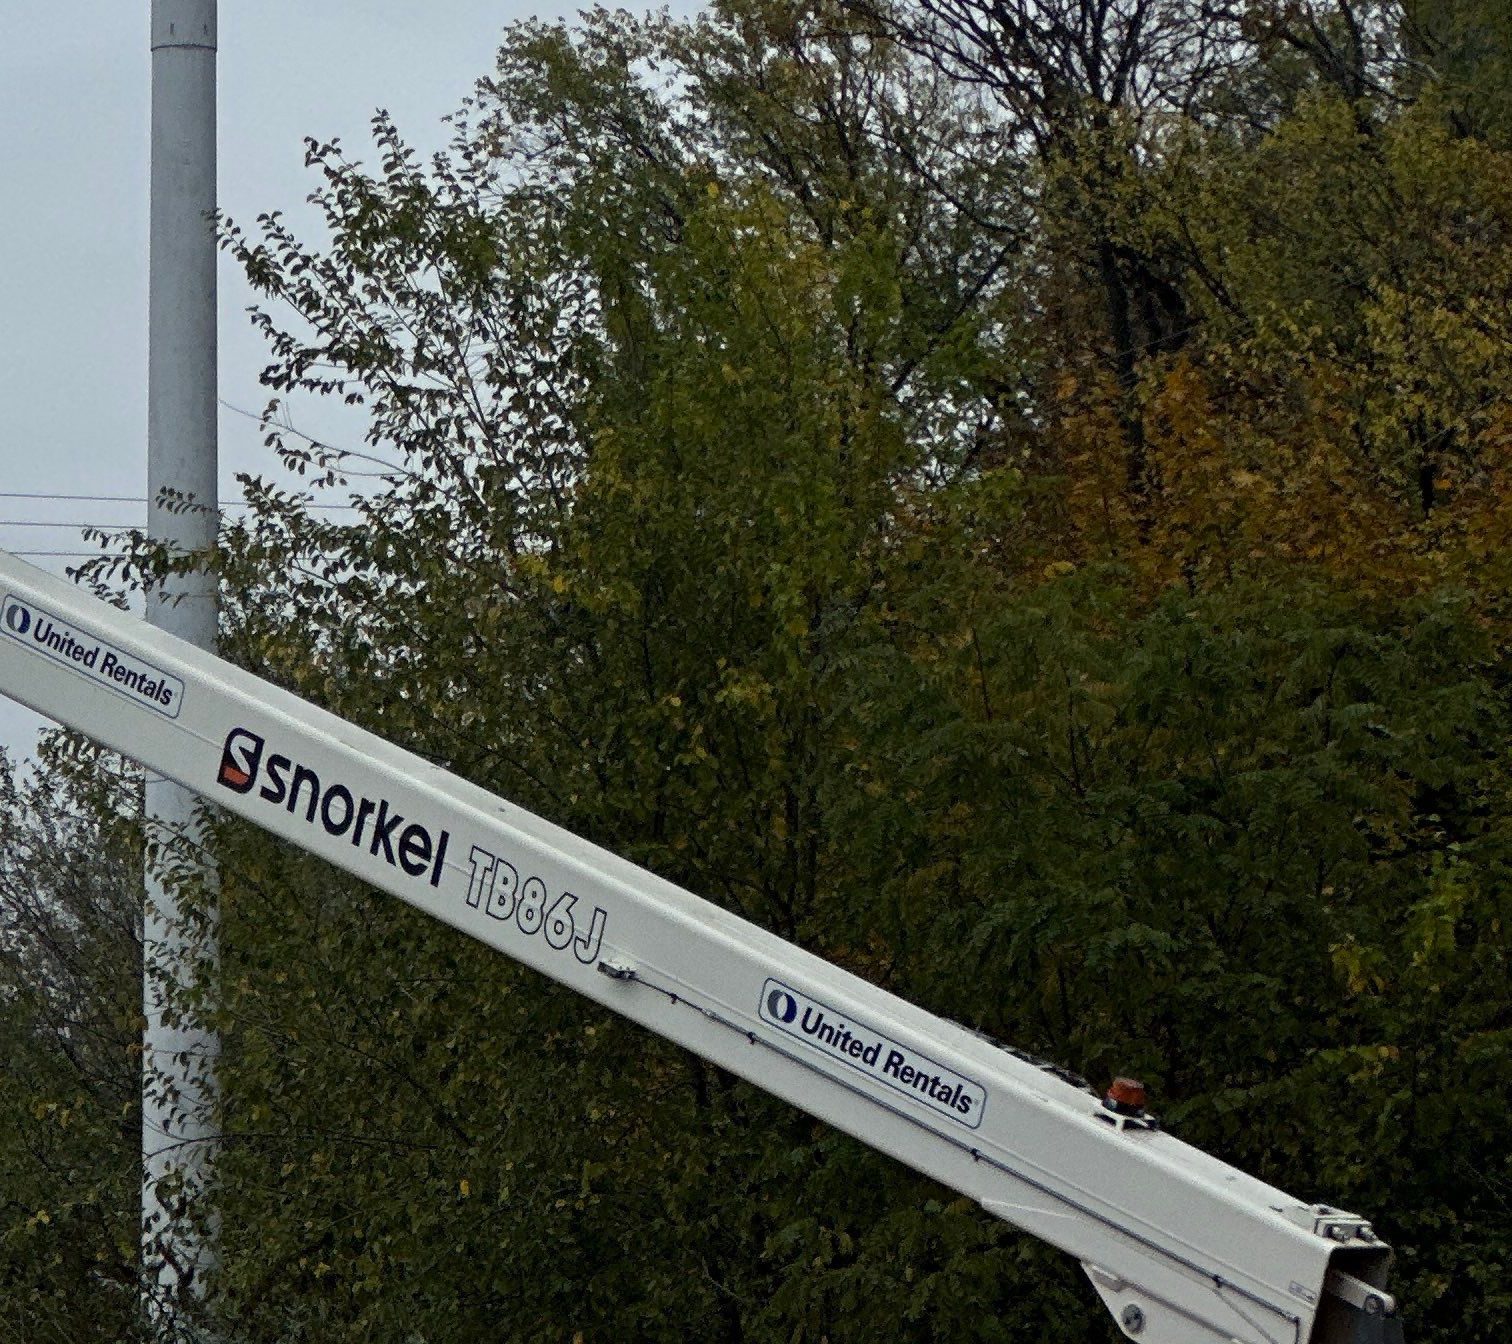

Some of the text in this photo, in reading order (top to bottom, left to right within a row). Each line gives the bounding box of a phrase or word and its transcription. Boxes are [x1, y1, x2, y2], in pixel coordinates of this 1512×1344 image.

[33, 618, 173, 706] United Rentals
[259, 753, 450, 888] snorkel
[466, 844, 608, 965] TB86J
[800, 1007, 973, 1115] United Rentals
